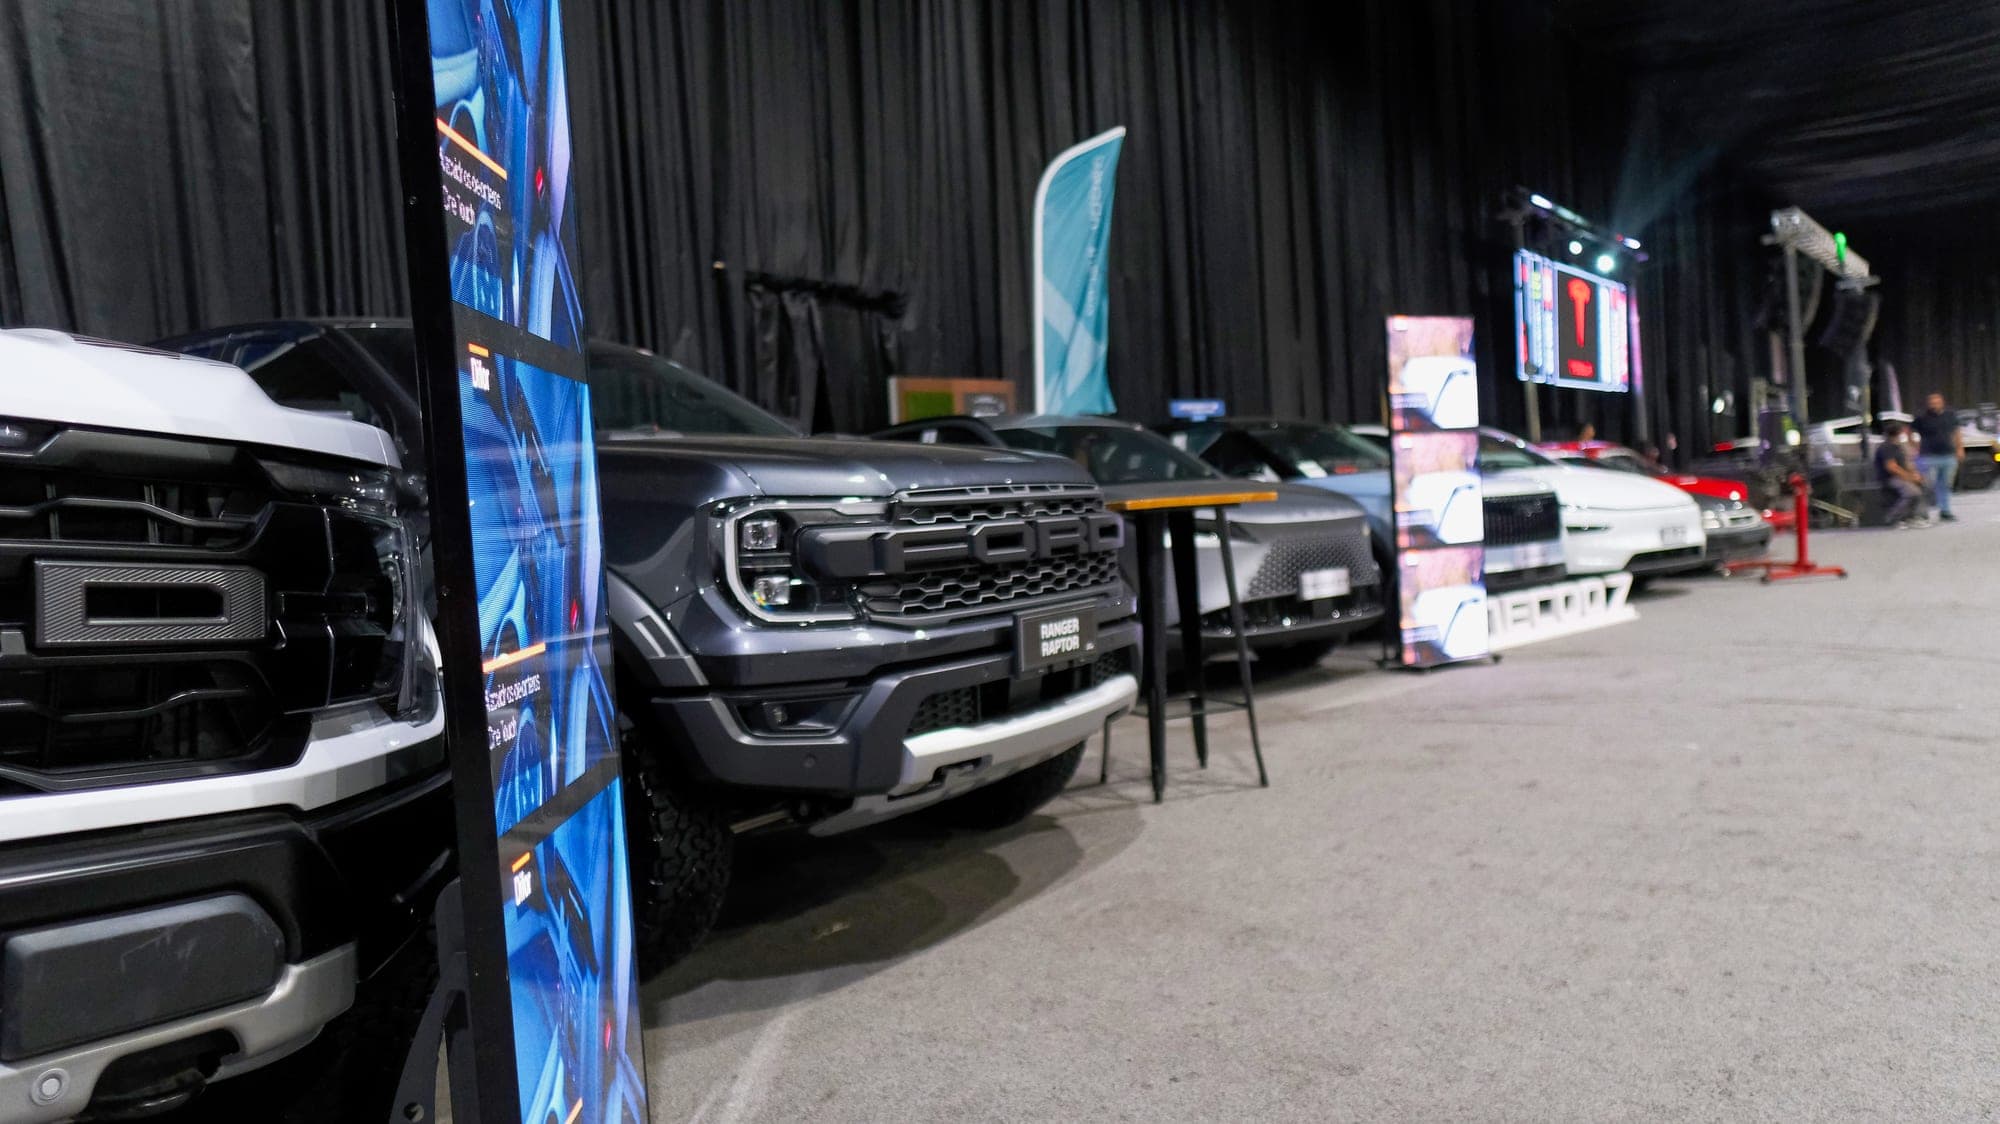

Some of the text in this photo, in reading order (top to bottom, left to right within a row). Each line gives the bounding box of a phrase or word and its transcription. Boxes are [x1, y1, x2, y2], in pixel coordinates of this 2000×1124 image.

[879, 514, 1125, 575] FORD
[1041, 617, 1080, 640] RANGER
[1041, 635, 1080, 657] RAPTOR
